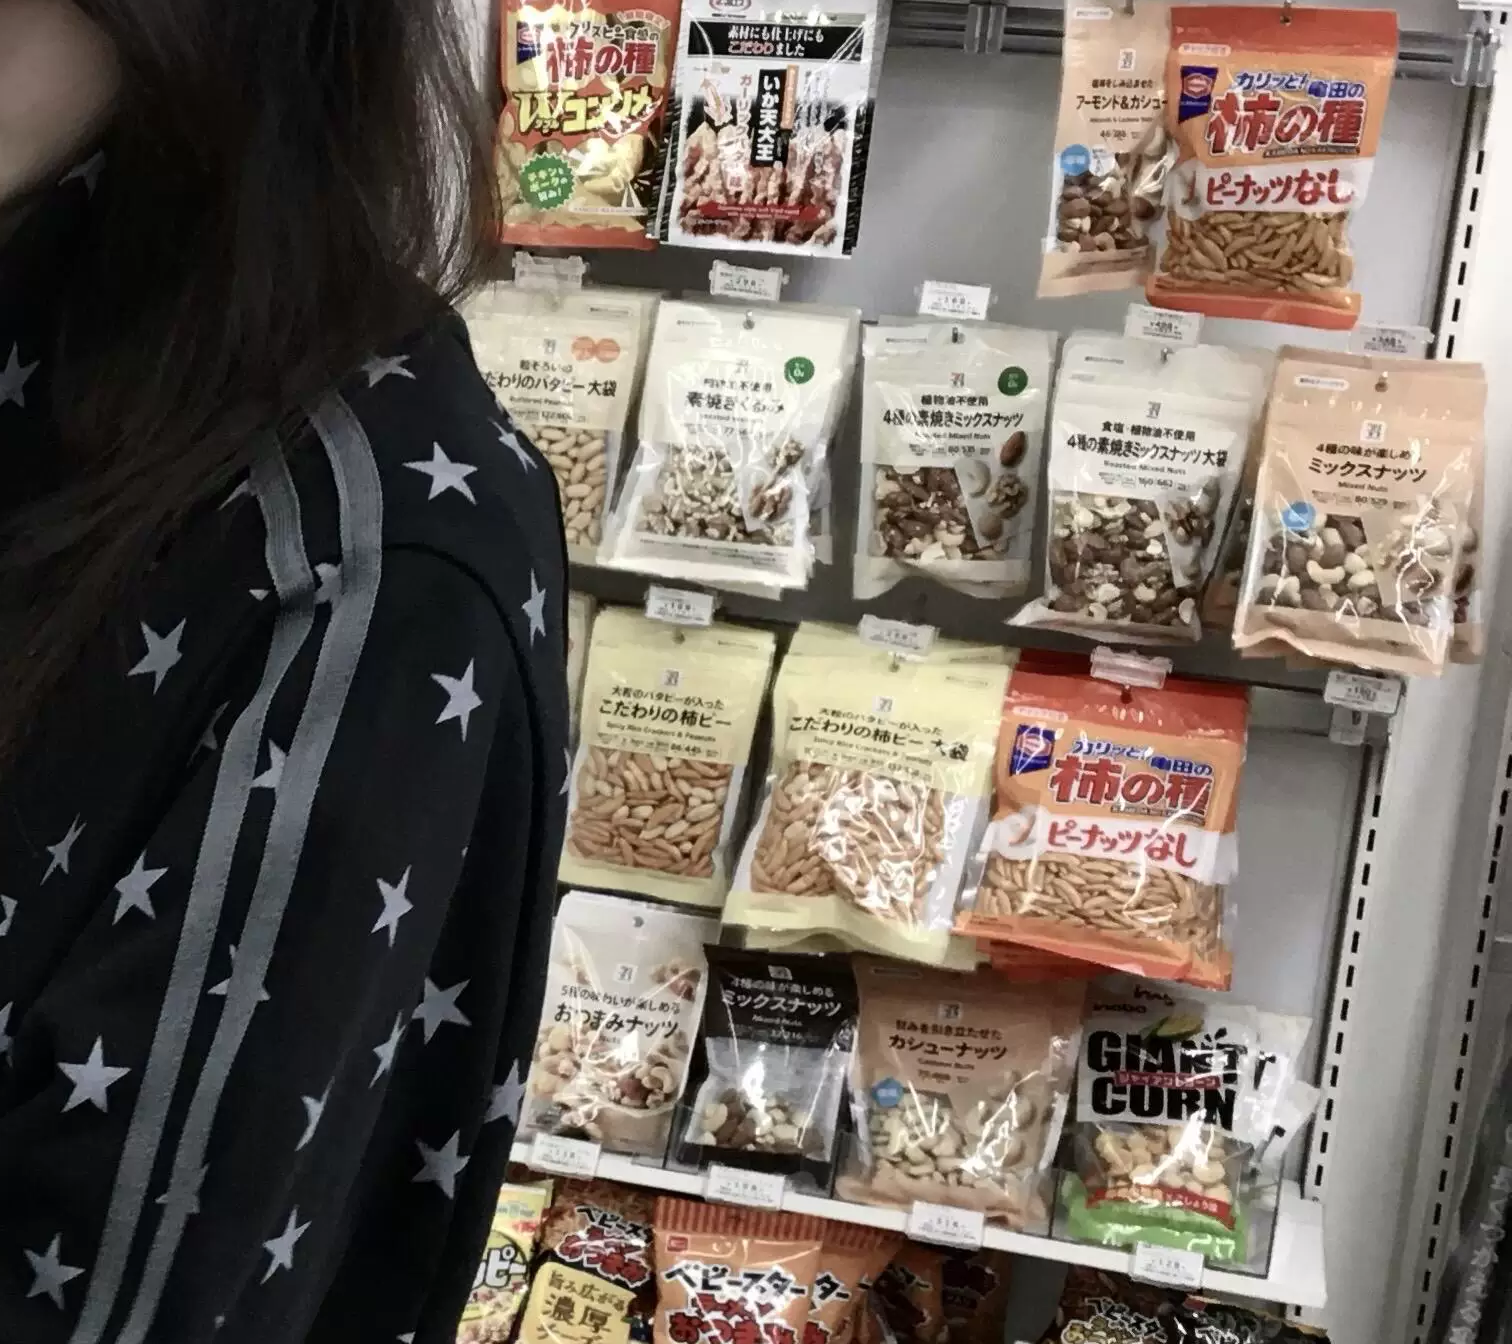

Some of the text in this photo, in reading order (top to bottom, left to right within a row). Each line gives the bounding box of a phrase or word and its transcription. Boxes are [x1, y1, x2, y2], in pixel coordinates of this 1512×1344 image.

[727, 25, 825, 45] 素材にも仕上げにも
[754, 73, 782, 163] いか天大王
[1206, 95, 1368, 154] 柿の種
[1207, 168, 1353, 206] ピーナッツなし
[1307, 458, 1428, 483] ミックスナッツ
[599, 700, 734, 729] こだわりの柿ピー
[789, 716, 926, 749] こだわりの柿ピー
[1048, 756, 1215, 816] 柿の種
[1048, 820, 1199, 868] ピーナッツなし
[721, 991, 842, 1018] ミックスナッツ
[887, 1033, 1009, 1059] カシューナッツ
[1090, 1076, 1237, 1132] CORN
[665, 1264, 806, 1300] ベビースター
[544, 1294, 612, 1336] 濃厚
